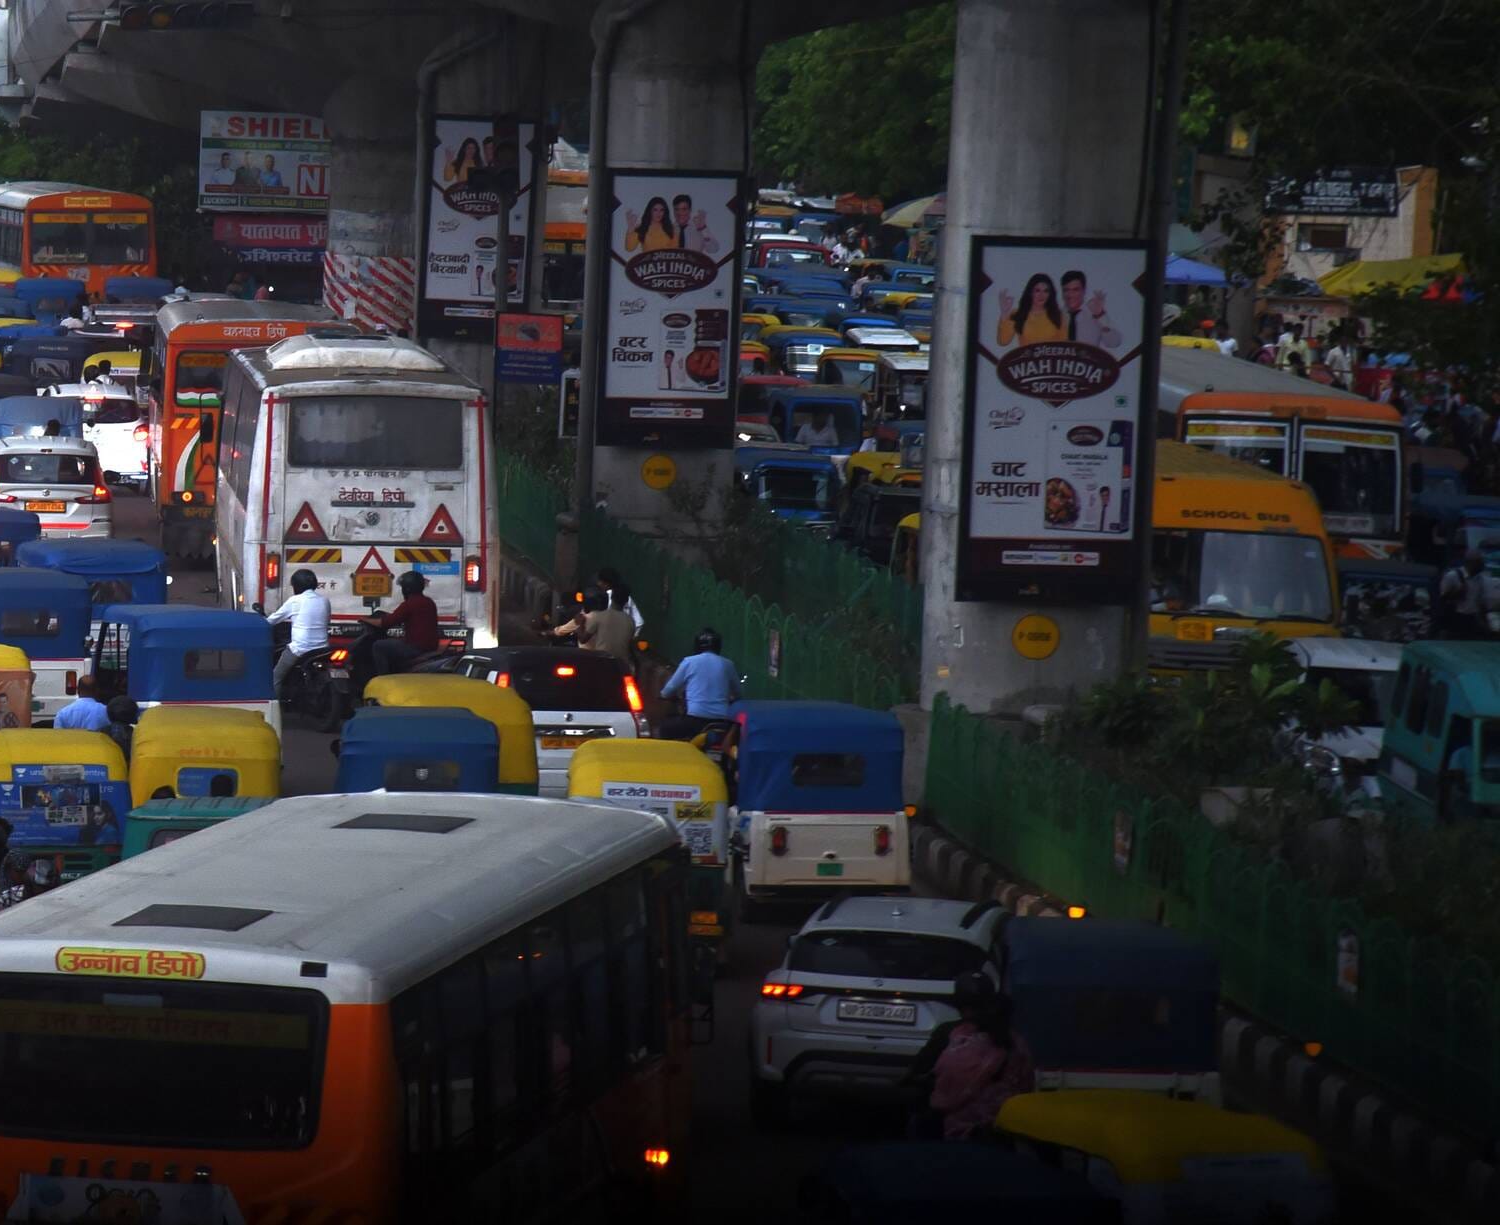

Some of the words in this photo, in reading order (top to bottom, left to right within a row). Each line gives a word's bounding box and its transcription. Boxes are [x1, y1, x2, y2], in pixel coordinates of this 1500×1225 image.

[227, 116, 331, 139] SHIEL
[634, 262, 667, 278] WAH
[670, 262, 706, 281] INDIA
[651, 278, 686, 289] SPICES
[618, 336, 649, 349] बटर
[611, 347, 654, 363] चिकन
[1008, 358, 1052, 380] WAH
[1055, 359, 1106, 385] INDIA
[1030, 382, 1078, 395] SPICES
[990, 462, 1028, 476] चाट
[974, 482, 1043, 498] मसाला
[1181, 509, 1252, 520] SCHOOL
[1257, 512, 1291, 522] BUS
[626, 786, 649, 798] रोटी
[63, 951, 142, 973] उन्नाव
[146, 950, 199, 977] डिपो
